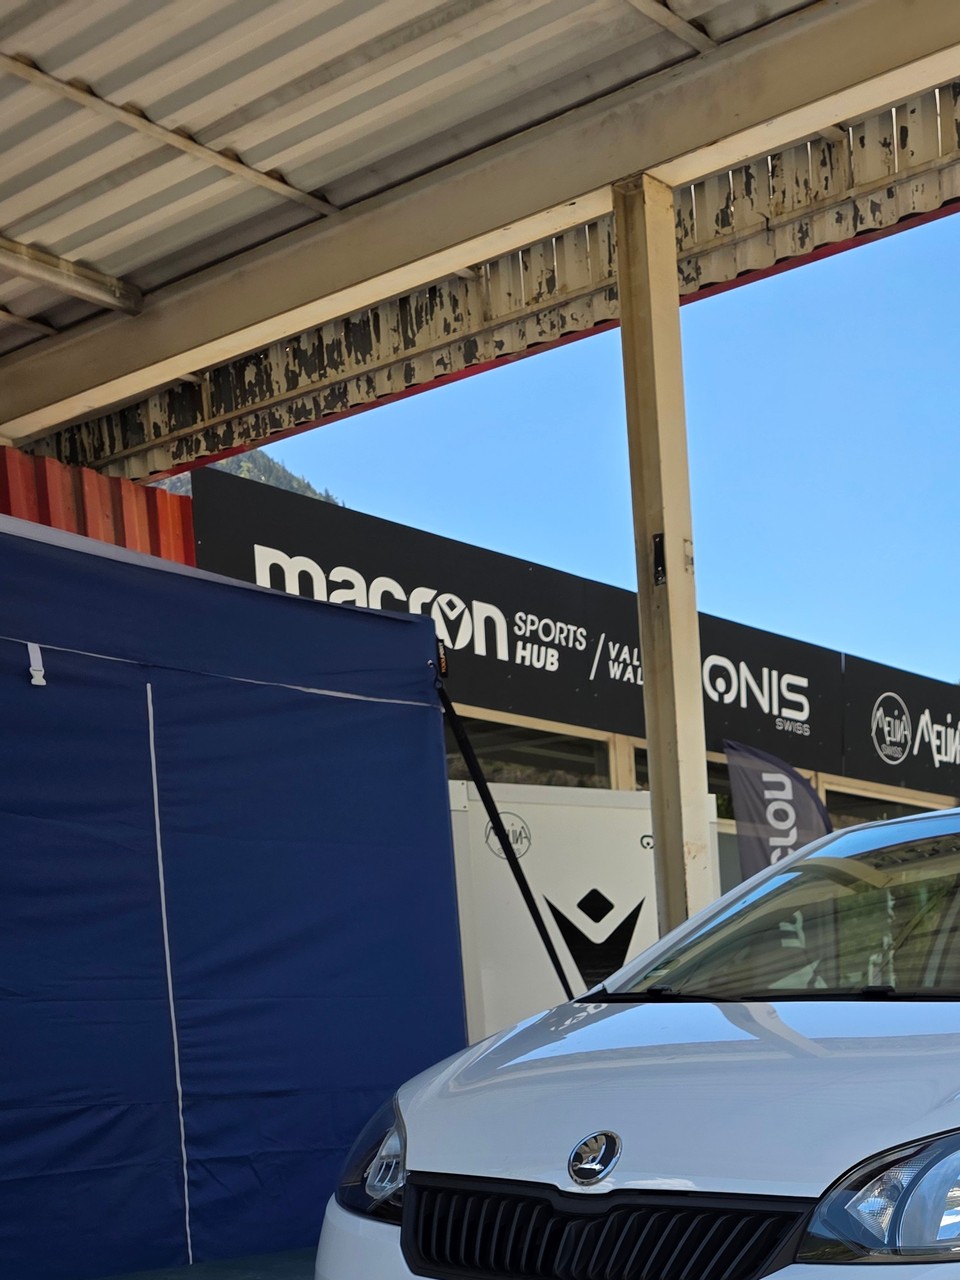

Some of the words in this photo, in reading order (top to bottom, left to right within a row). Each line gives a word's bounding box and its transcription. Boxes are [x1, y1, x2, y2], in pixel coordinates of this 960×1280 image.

[513, 611, 587, 651] SPORTS
[515, 641, 560, 671] HUB
[702, 654, 810, 721] ONIS
[775, 718, 811, 736] SWISS
